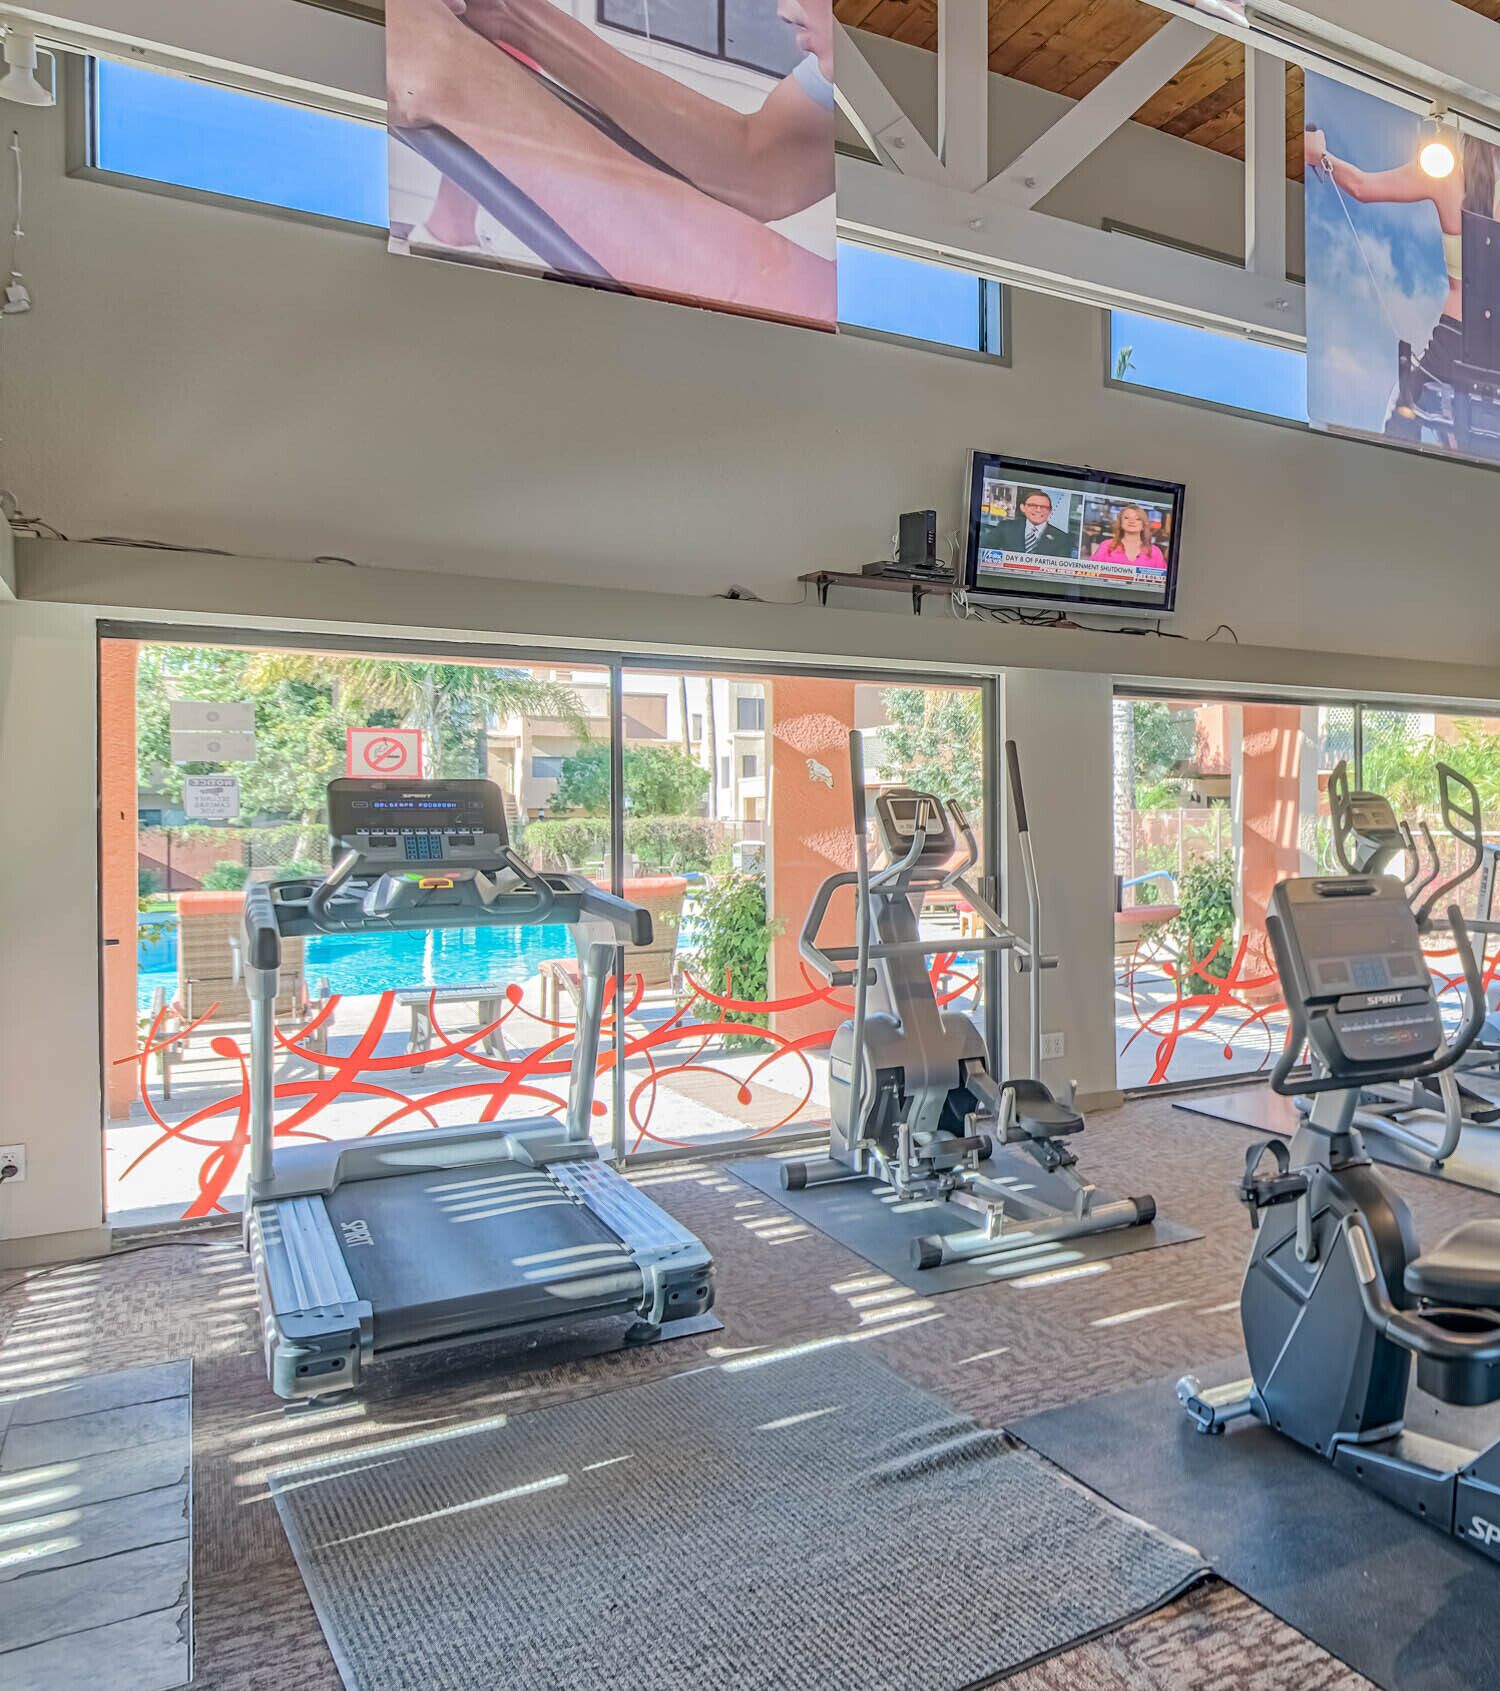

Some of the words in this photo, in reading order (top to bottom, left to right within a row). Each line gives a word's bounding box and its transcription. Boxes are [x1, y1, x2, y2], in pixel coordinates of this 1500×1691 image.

[1005, 554, 1019, 562] DAY
[1025, 556, 1034, 564] OF
[1034, 557, 1057, 567] PARTIAL
[1058, 560, 1099, 571] GOVERNMENT
[1100, 564, 1133, 574] SHUTDOWN
[1367, 992, 1403, 1006] SPIRIT
